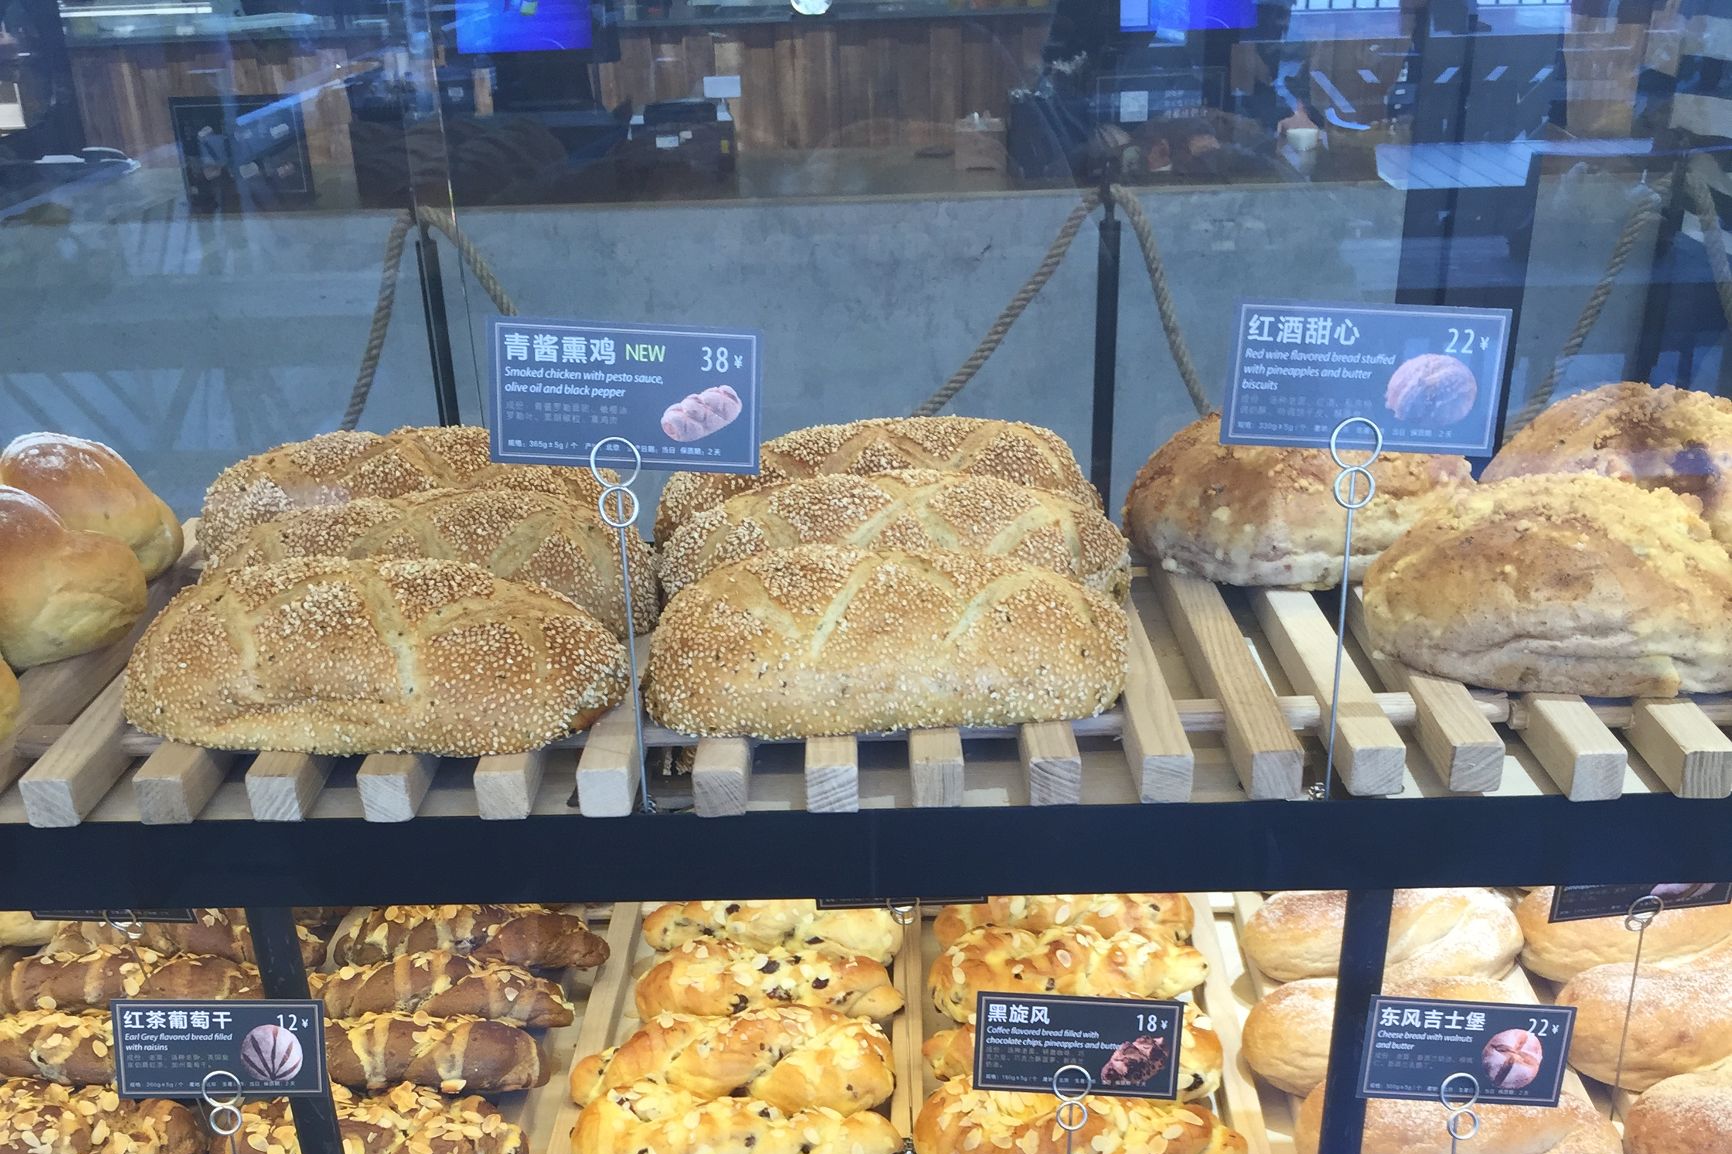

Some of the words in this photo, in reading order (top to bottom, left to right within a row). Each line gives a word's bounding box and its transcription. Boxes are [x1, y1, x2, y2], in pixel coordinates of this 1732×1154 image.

[1247, 314, 1360, 345] 红酒甜心
[504, 333, 616, 365] 青酱熏鸡
[625, 343, 666, 363] NEW
[1245, 348, 1264, 359] Red
[1265, 350, 1289, 361] wine
[1290, 350, 1331, 362] flavored
[1331, 352, 1361, 364] bread
[1361, 353, 1396, 366] stuffed
[504, 366, 544, 378] Smoked
[544, 368, 582, 380] chicken
[583, 370, 605, 382] with
[605, 373, 633, 384] pesto
[634, 374, 664, 385] sauce,
[1243, 363, 1266, 374] with
[1266, 364, 1320, 378] pineapples
[1320, 367, 1342, 378] and
[1342, 368, 1372, 379] butter
[504, 381, 528, 393] olive
[529, 382, 542, 393] oil
[543, 383, 563, 394] and
[564, 384, 590, 396] black
[591, 388, 626, 399] pepper
[1241, 379, 1278, 391] biscuits
[123, 1010, 233, 1030] 红茶葡萄干
[987, 1004, 1051, 1025] 黑旋风
[1379, 1006, 1486, 1031] 东风吉士堡
[125, 1033, 140, 1041] Earl
[141, 1033, 158, 1042] Grey
[159, 1032, 190, 1041] flavored
[191, 1033, 213, 1041] bread
[214, 1033, 233, 1041] filled
[986, 1026, 1010, 1035] Coffee
[1011, 1026, 1041, 1036] flavored
[1041, 1028, 1063, 1037] bread
[1064, 1029, 1082, 1038] filled
[1083, 1030, 1100, 1039] with
[1377, 1030, 1403, 1039] Cheese
[1404, 1031, 1426, 1040] bread
[1426, 1033, 1443, 1041] with
[1443, 1034, 1473, 1043] walnuts
[125, 1043, 143, 1051] with
[144, 1043, 168, 1051] raisins
[986, 1036, 1021, 1046] chocolate
[1043, 1039, 1083, 1049] pineapples
[1084, 1041, 1100, 1049] and
[1375, 1041, 1391, 1049] and
[1391, 1042, 1415, 1050] butter
